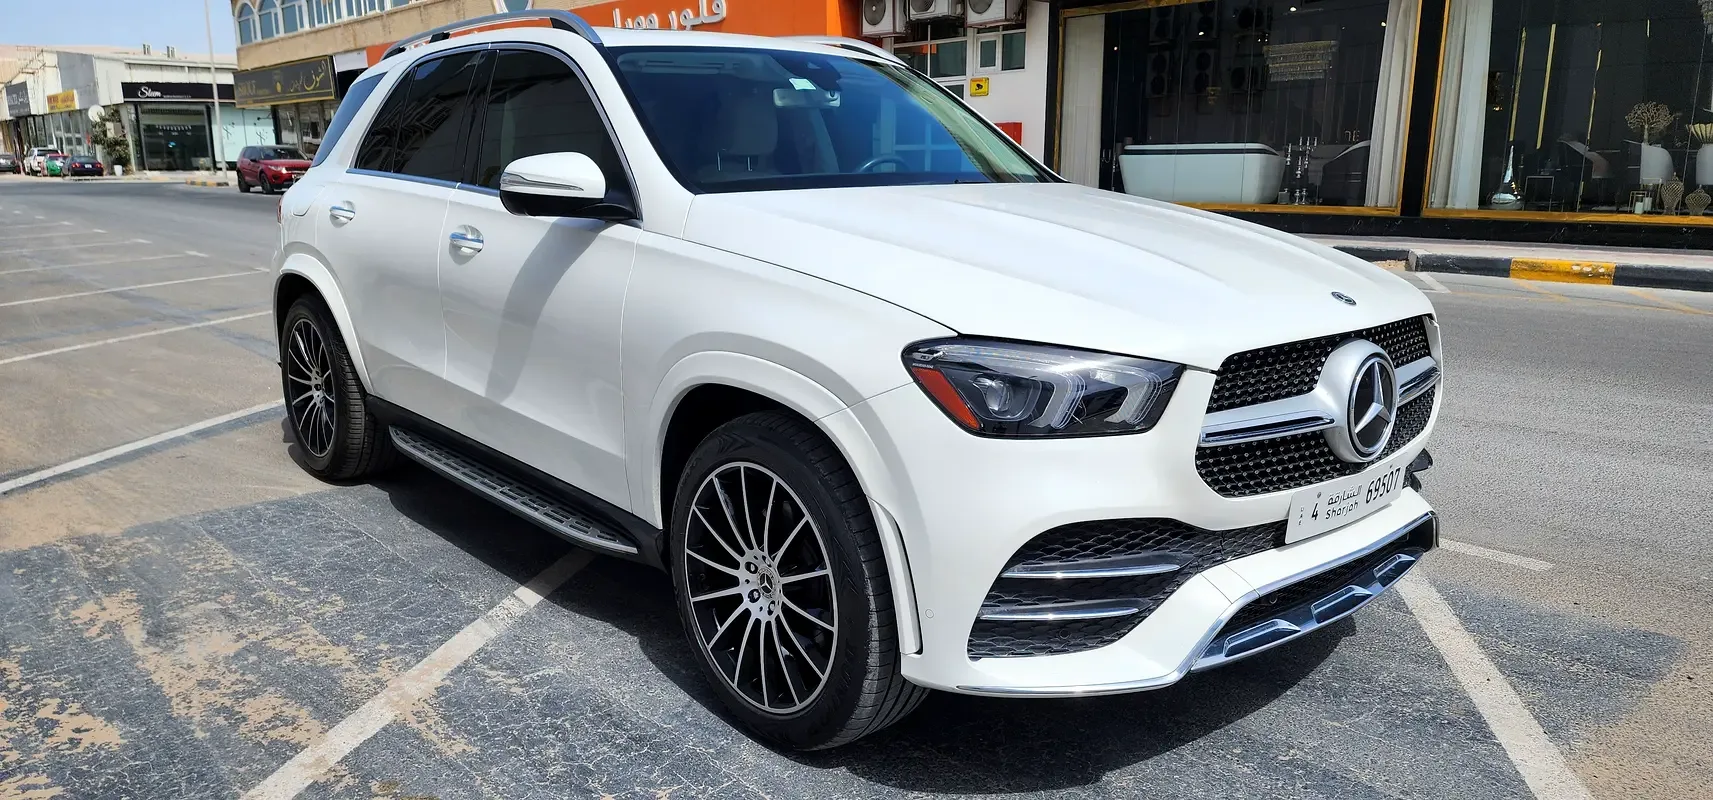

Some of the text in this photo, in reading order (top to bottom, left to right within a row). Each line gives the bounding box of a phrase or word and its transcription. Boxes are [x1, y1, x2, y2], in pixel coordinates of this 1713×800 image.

[1327, 484, 1363, 506] الشارقة
[1365, 467, 1401, 504] 69507
[1311, 502, 1319, 521] 4
[1325, 498, 1359, 520] Sharjah
